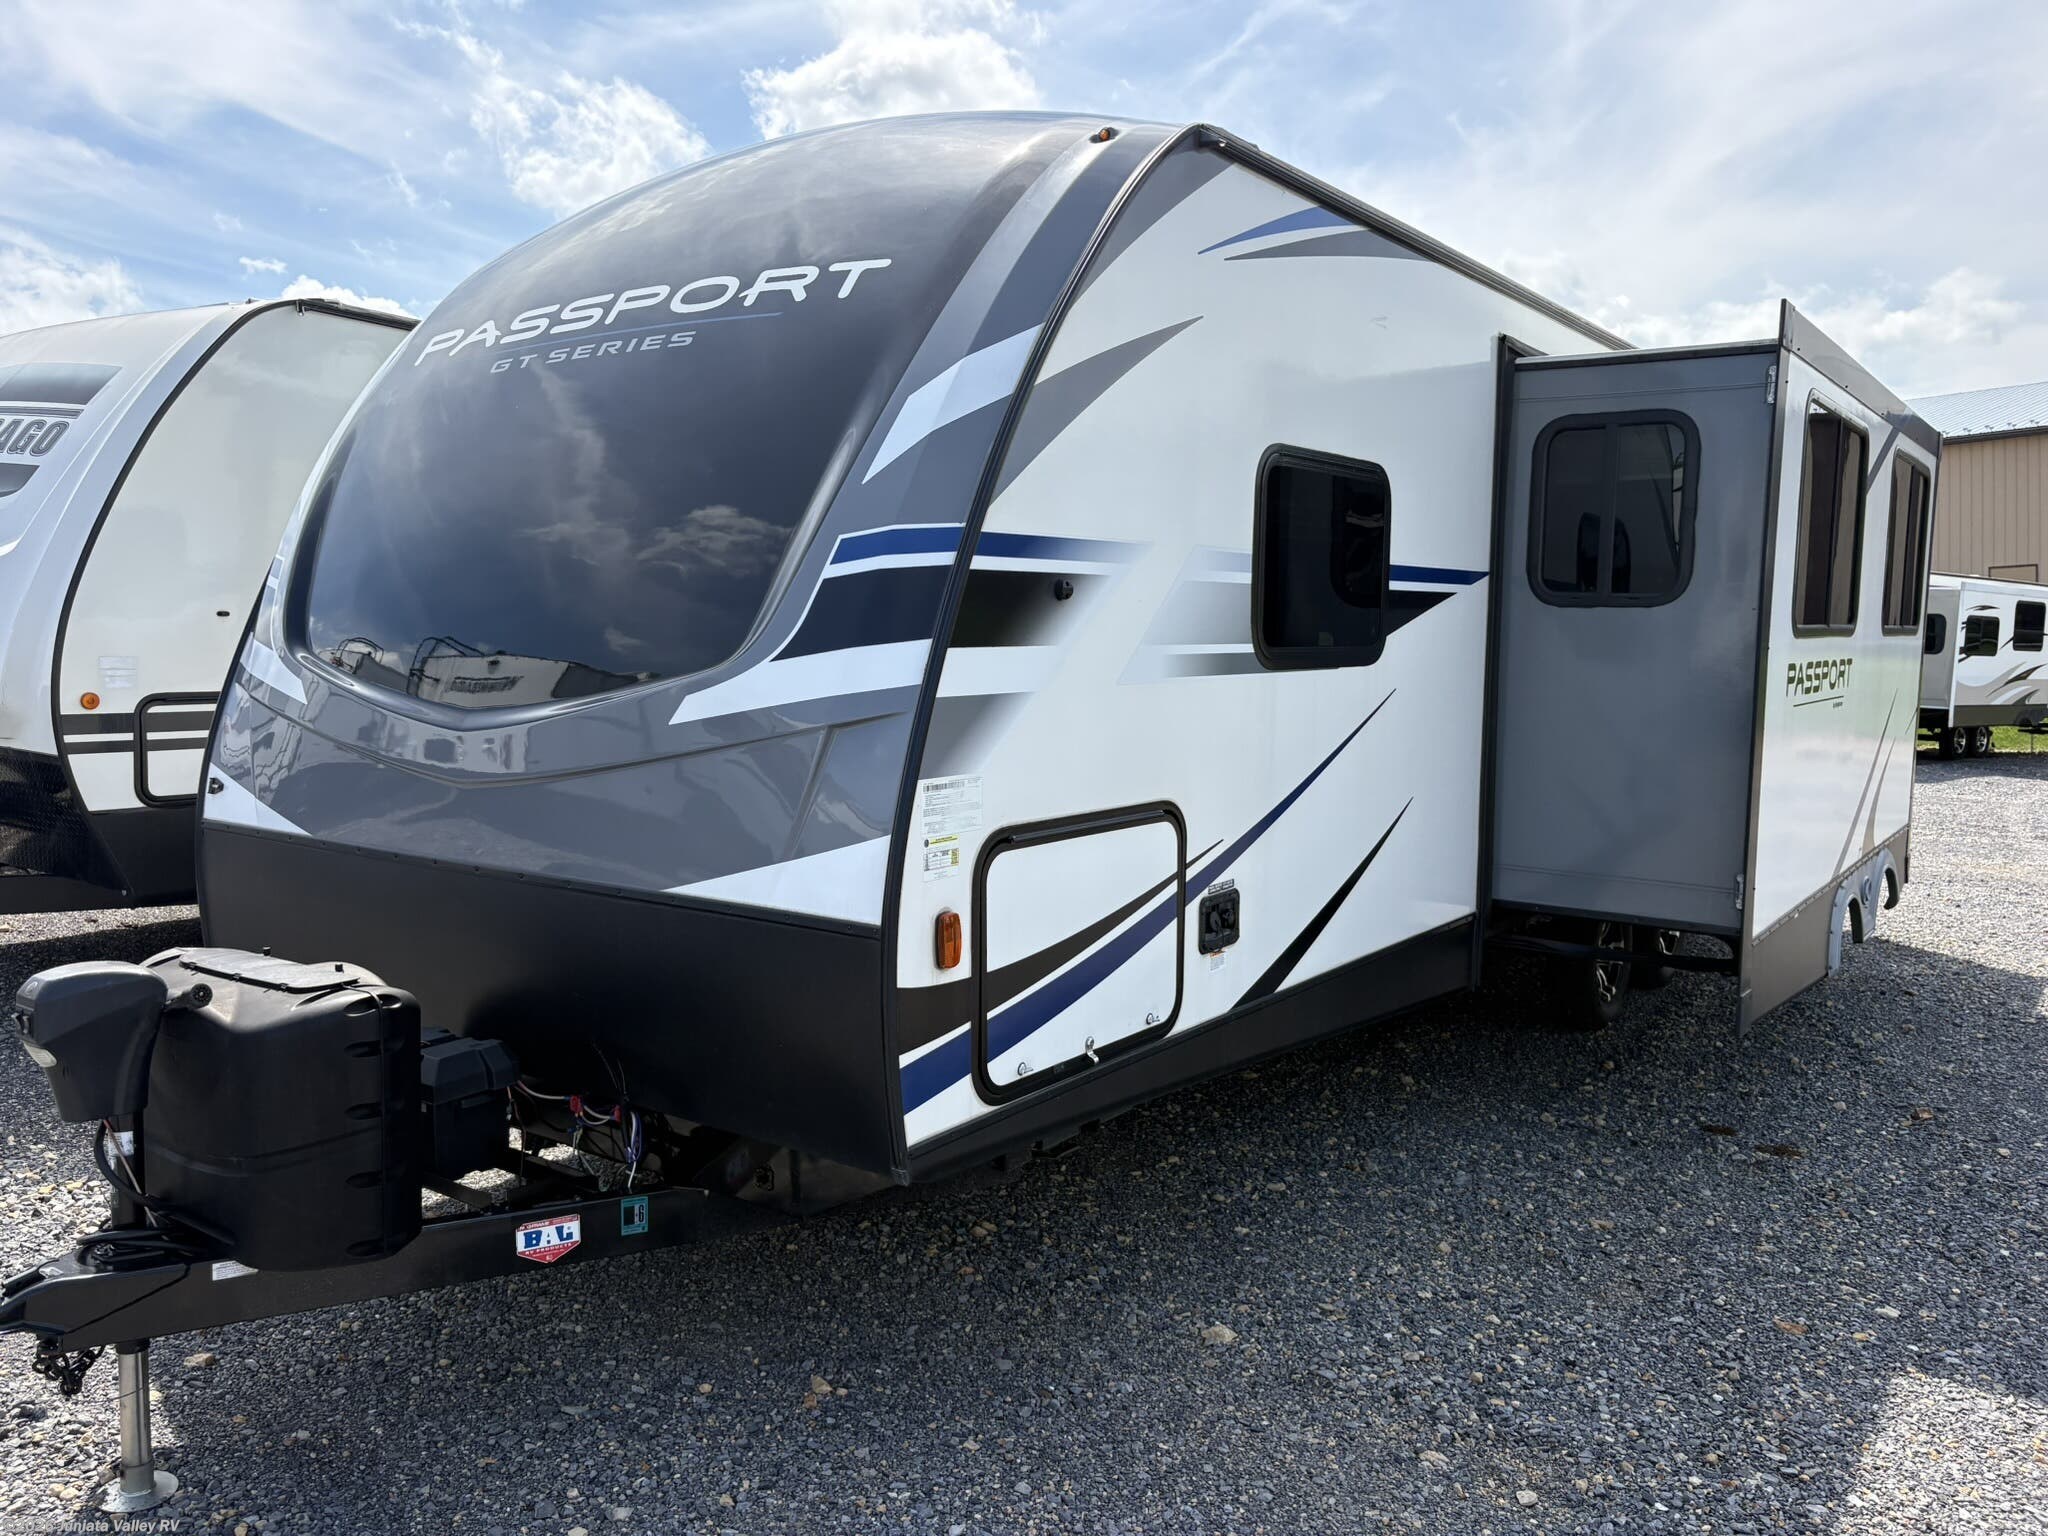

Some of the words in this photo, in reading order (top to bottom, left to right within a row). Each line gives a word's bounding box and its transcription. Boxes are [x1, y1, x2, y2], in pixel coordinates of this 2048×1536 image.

[414, 258, 892, 366] PASSPORT
[490, 354, 538, 374] GT
[545, 331, 697, 364] SERIES
[0, 418, 70, 457] AGO
[1786, 658, 1853, 697] PASSPORT
[523, 1225, 574, 1249] BAL
